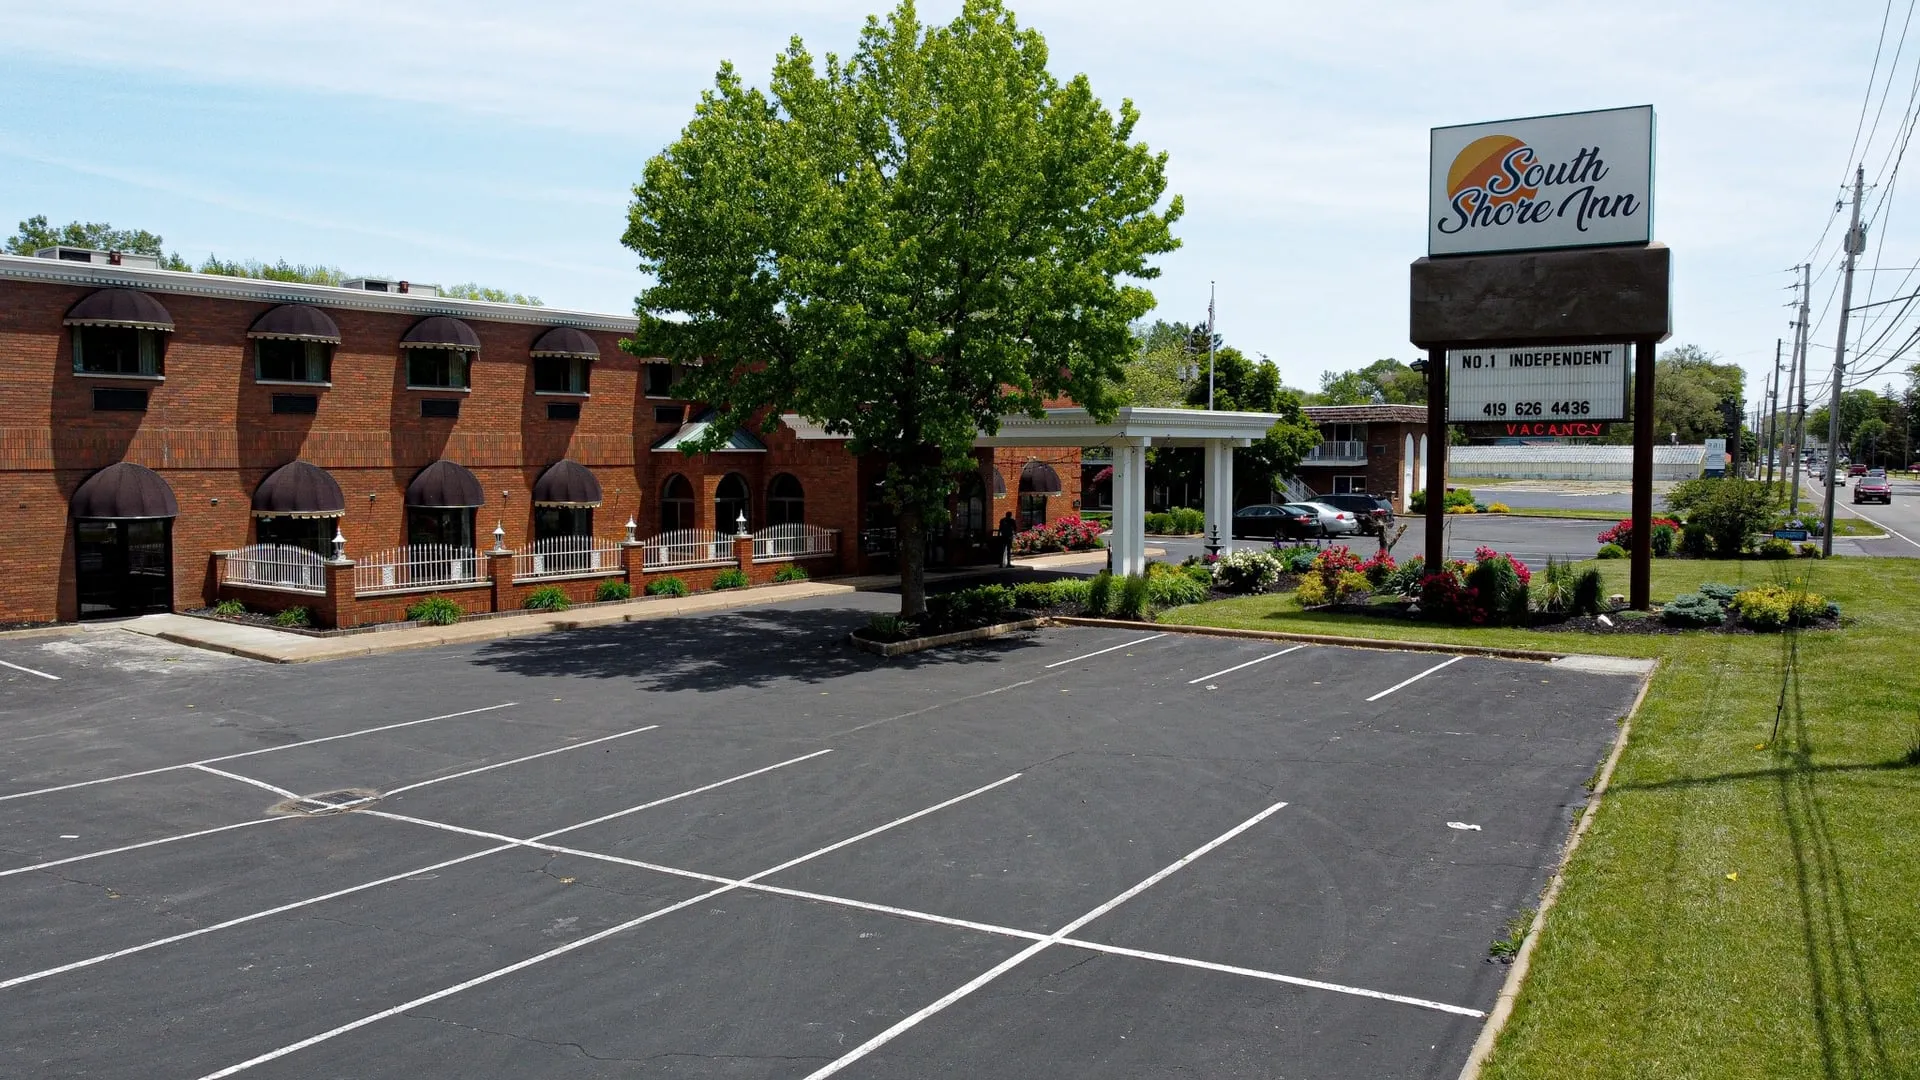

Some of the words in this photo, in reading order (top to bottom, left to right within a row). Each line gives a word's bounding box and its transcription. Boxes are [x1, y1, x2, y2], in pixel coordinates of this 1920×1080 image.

[1488, 147, 1609, 194] South
[1437, 188, 1554, 234] Shore
[1557, 185, 1640, 232] Inn
[1509, 350, 1612, 367] INDEPENDENT
[1483, 402, 1507, 416] 419
[1515, 402, 1542, 416] 626
[1551, 401, 1590, 415] 4436
[1506, 423, 1602, 436] VACANCY
